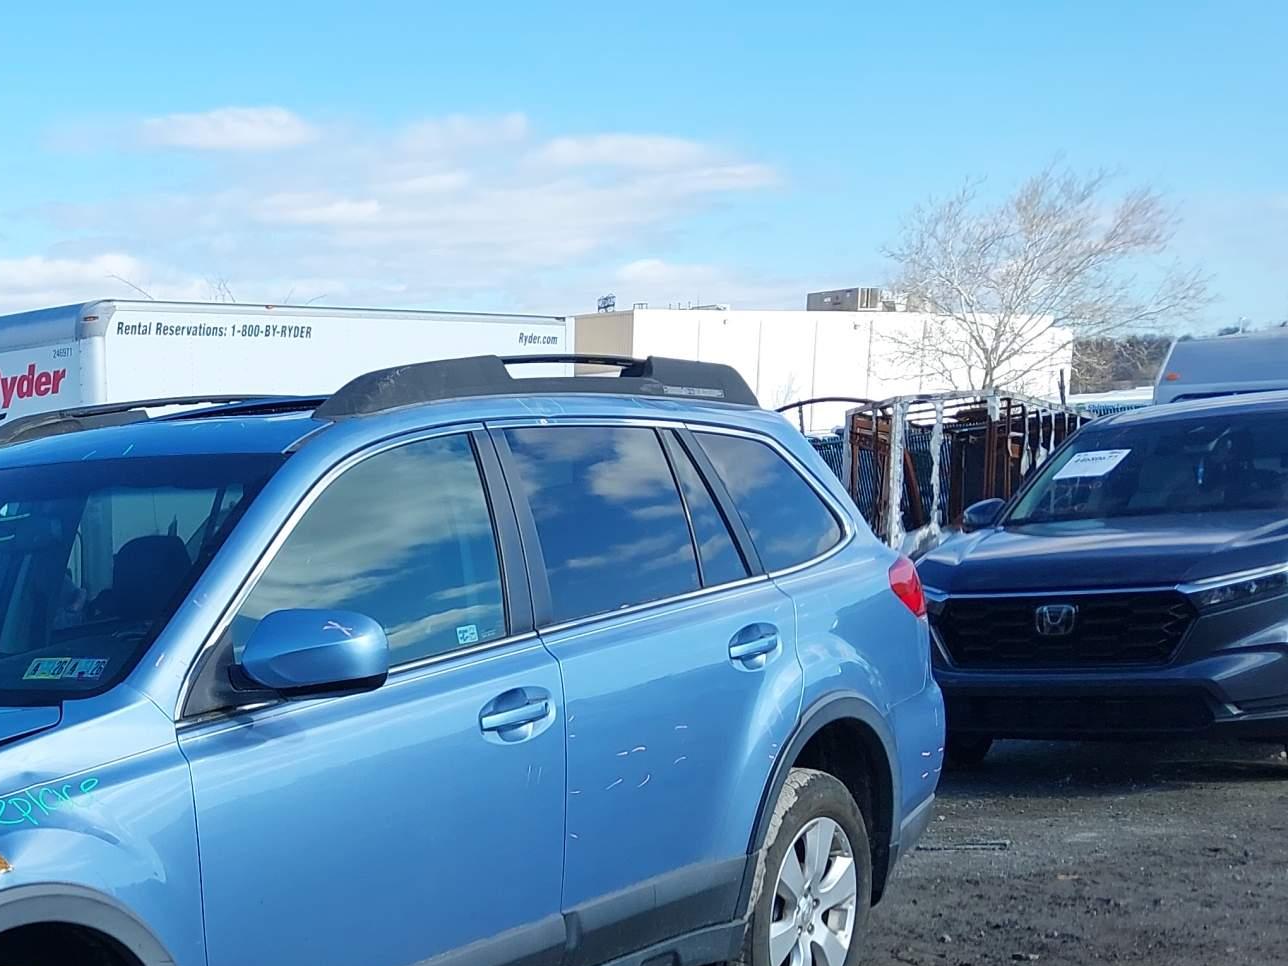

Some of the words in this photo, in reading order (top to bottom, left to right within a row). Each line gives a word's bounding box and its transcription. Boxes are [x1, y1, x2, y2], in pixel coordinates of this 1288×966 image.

[117, 322, 152, 335] Rental
[155, 322, 227, 337] Reservations:
[231, 324, 312, 338] 1-800-BY-RYDER
[518, 332, 558, 346] Ryder.com
